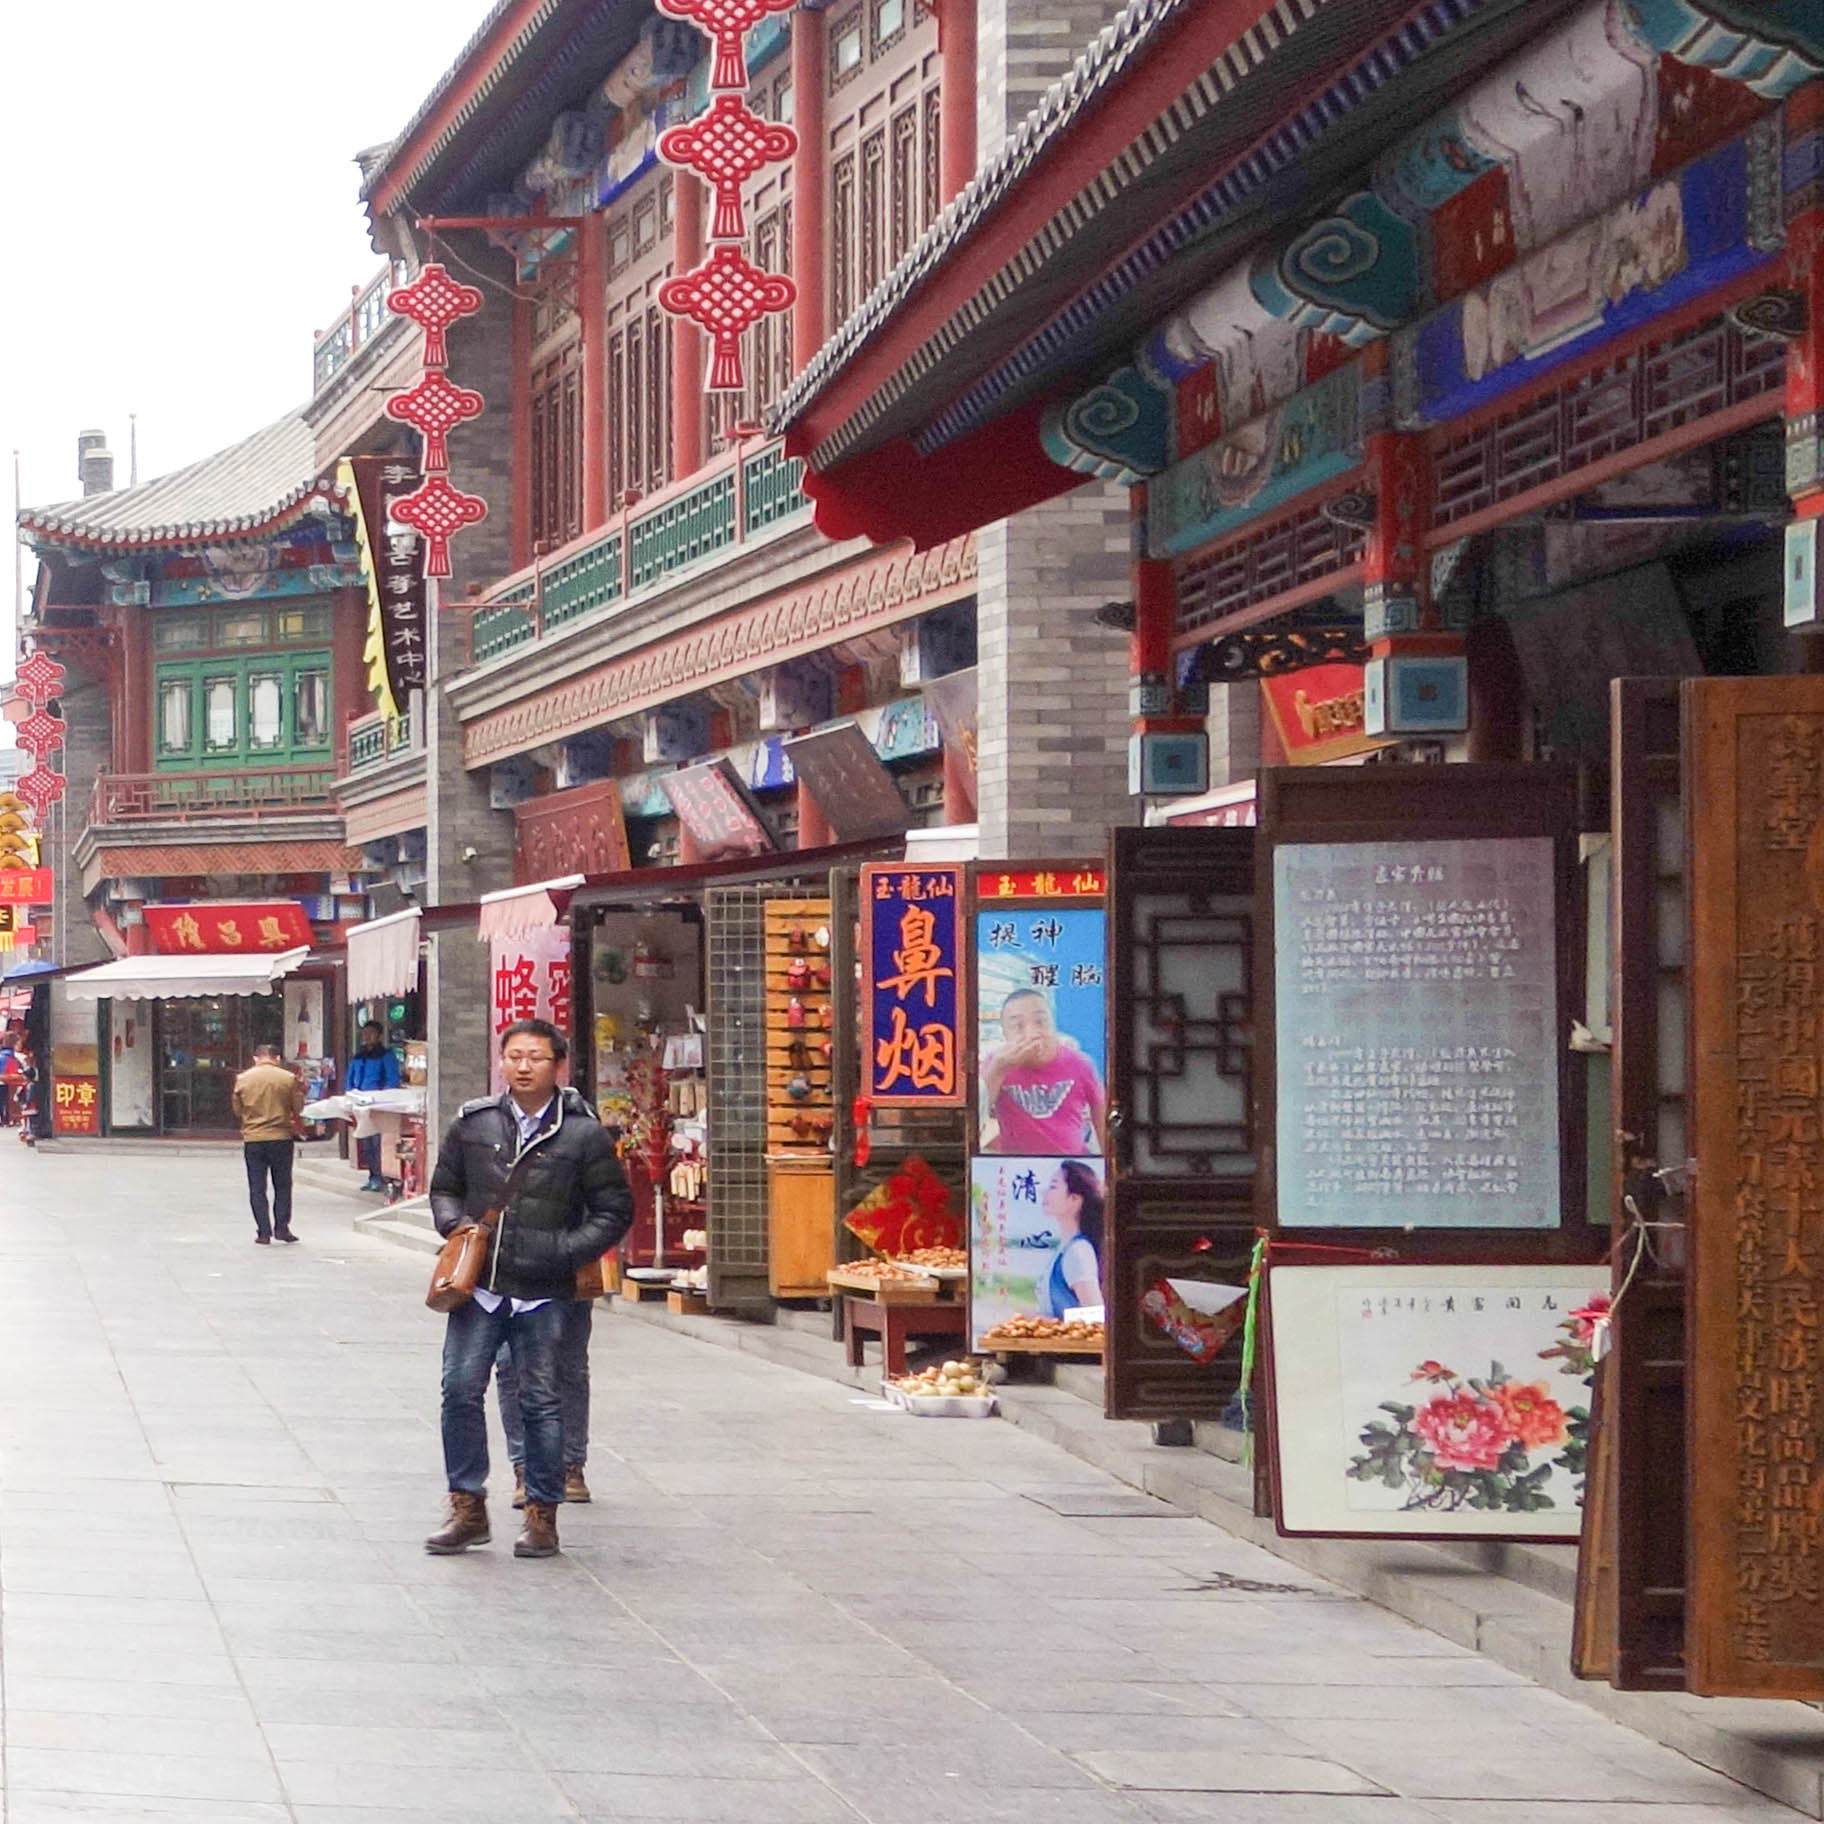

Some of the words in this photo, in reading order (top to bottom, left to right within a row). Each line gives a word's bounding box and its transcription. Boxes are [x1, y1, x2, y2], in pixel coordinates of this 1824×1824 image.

[990, 918, 1063, 950] 提神
[875, 904, 954, 1095] 鼻烟
[55, 1081, 97, 1107] 印章
[1012, 1169, 1053, 1249] 清心
